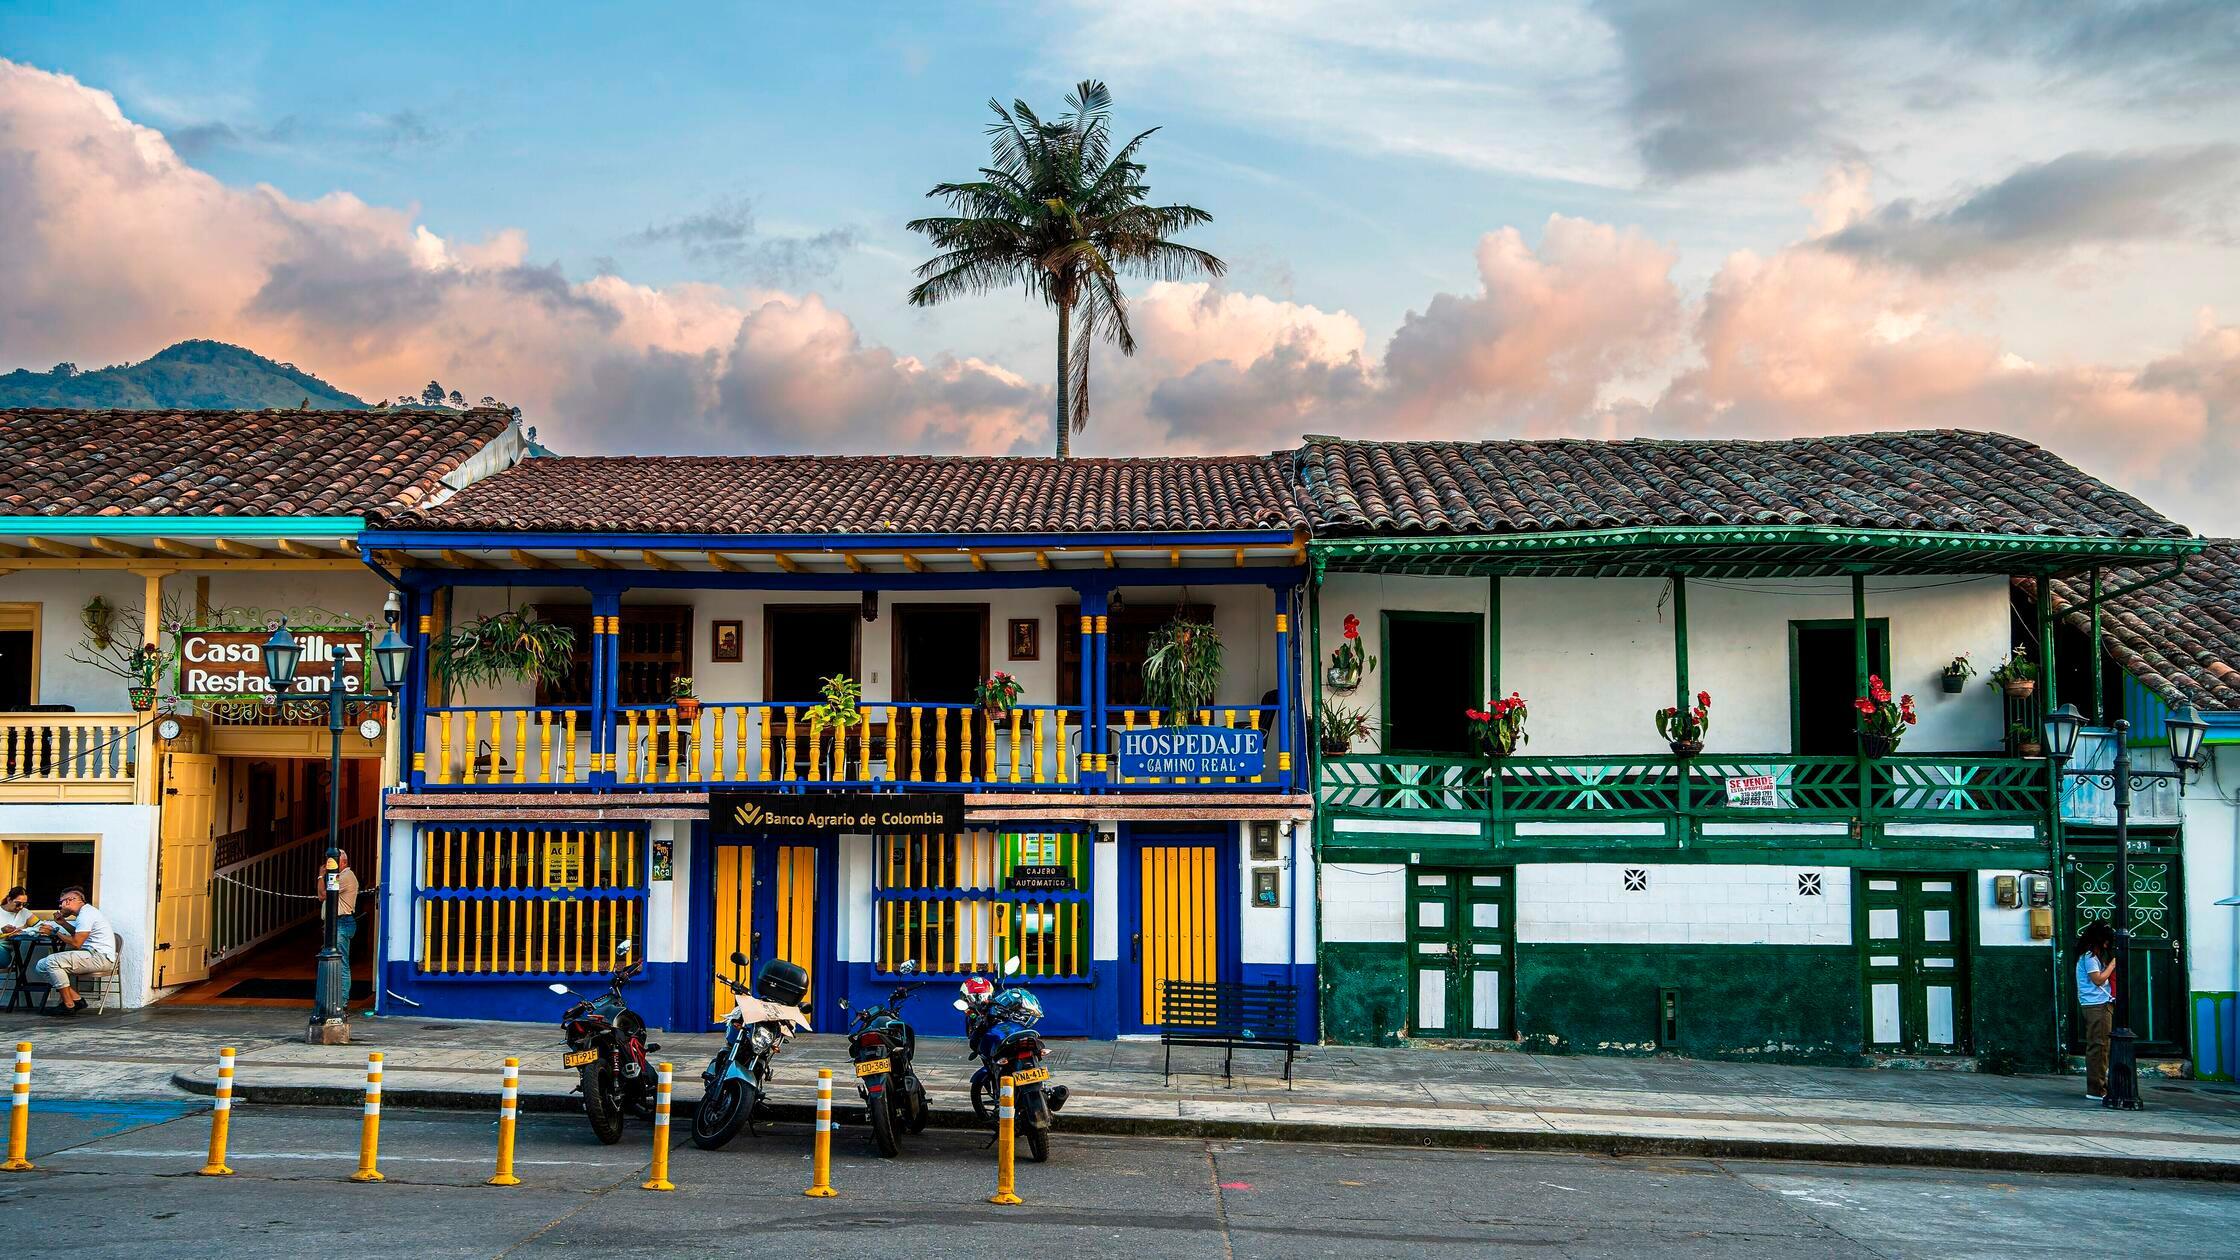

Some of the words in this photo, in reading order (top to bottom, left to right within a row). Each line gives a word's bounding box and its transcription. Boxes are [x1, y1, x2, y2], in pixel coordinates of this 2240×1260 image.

[184, 637, 260, 662] Casa
[188, 669, 360, 693] Restauane
[1125, 734, 1259, 756] HOSPEDAJE
[1147, 758, 1196, 773] CAMINO
[1201, 758, 1237, 772] REAL
[1730, 780, 1742, 789] SE
[1743, 777, 1773, 788] VENDE
[765, 812, 804, 826] Banco
[808, 813, 855, 829] Agrario
[860, 814, 876, 826] de
[881, 812, 944, 826] Colombia
[1016, 879, 1066, 887] AUTOMATICO
